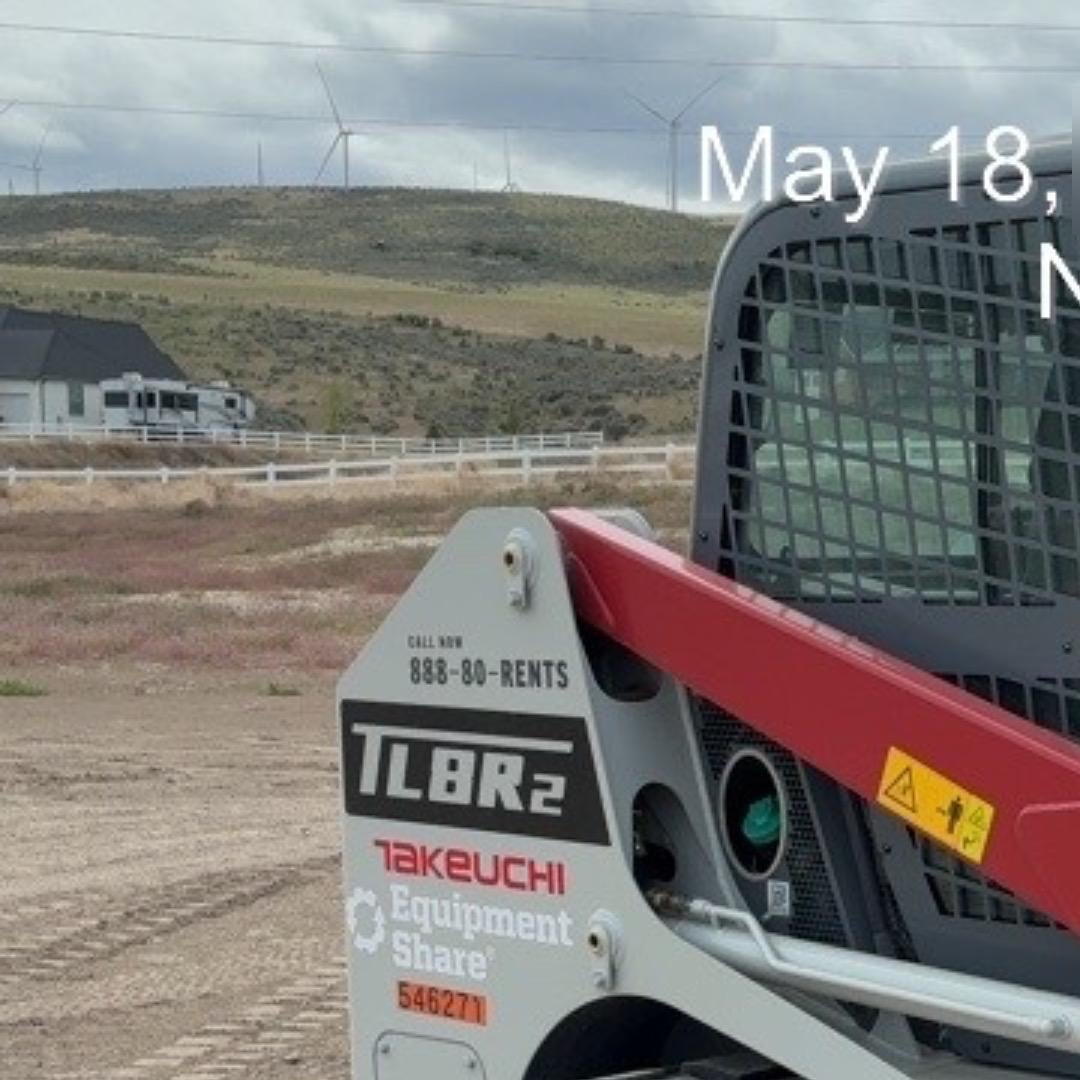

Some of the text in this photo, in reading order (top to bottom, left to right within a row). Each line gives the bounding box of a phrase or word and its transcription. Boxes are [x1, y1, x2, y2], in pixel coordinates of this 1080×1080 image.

[408, 635, 463, 649] CALL NOW
[410, 656, 569, 688] 888-80-RENTS
[374, 839, 565, 895] TAKEUCHI
[389, 884, 574, 946] Equipment
[391, 930, 488, 979] Share
